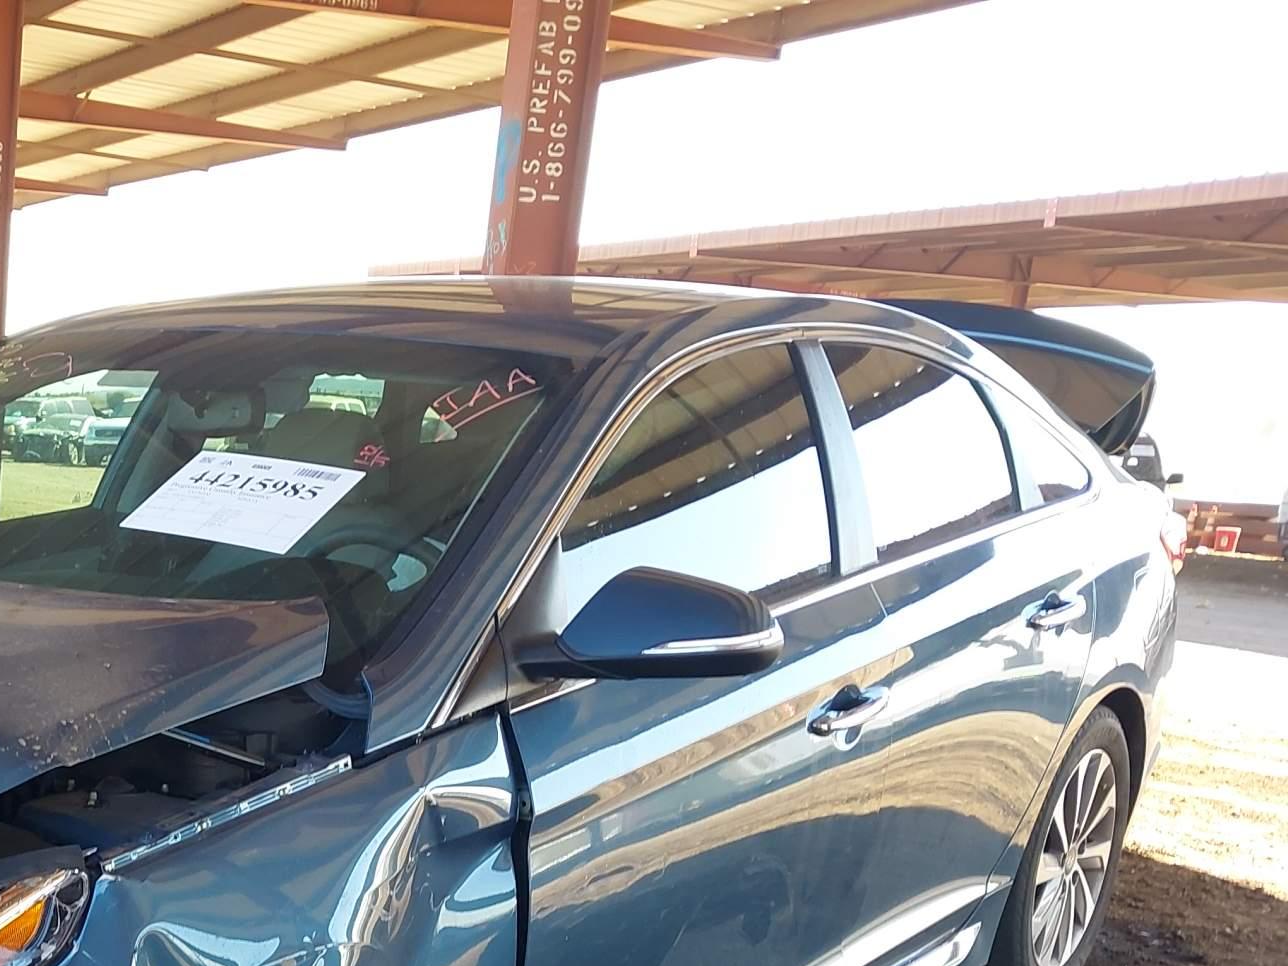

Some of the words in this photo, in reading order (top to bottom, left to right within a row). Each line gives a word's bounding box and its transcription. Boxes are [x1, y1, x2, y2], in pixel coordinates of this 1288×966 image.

[528, 20, 558, 133] PREFAB
[518, 151, 543, 204] U.S.
[432, 367, 536, 421] IAA
[188, 469, 326, 501] 44215985
